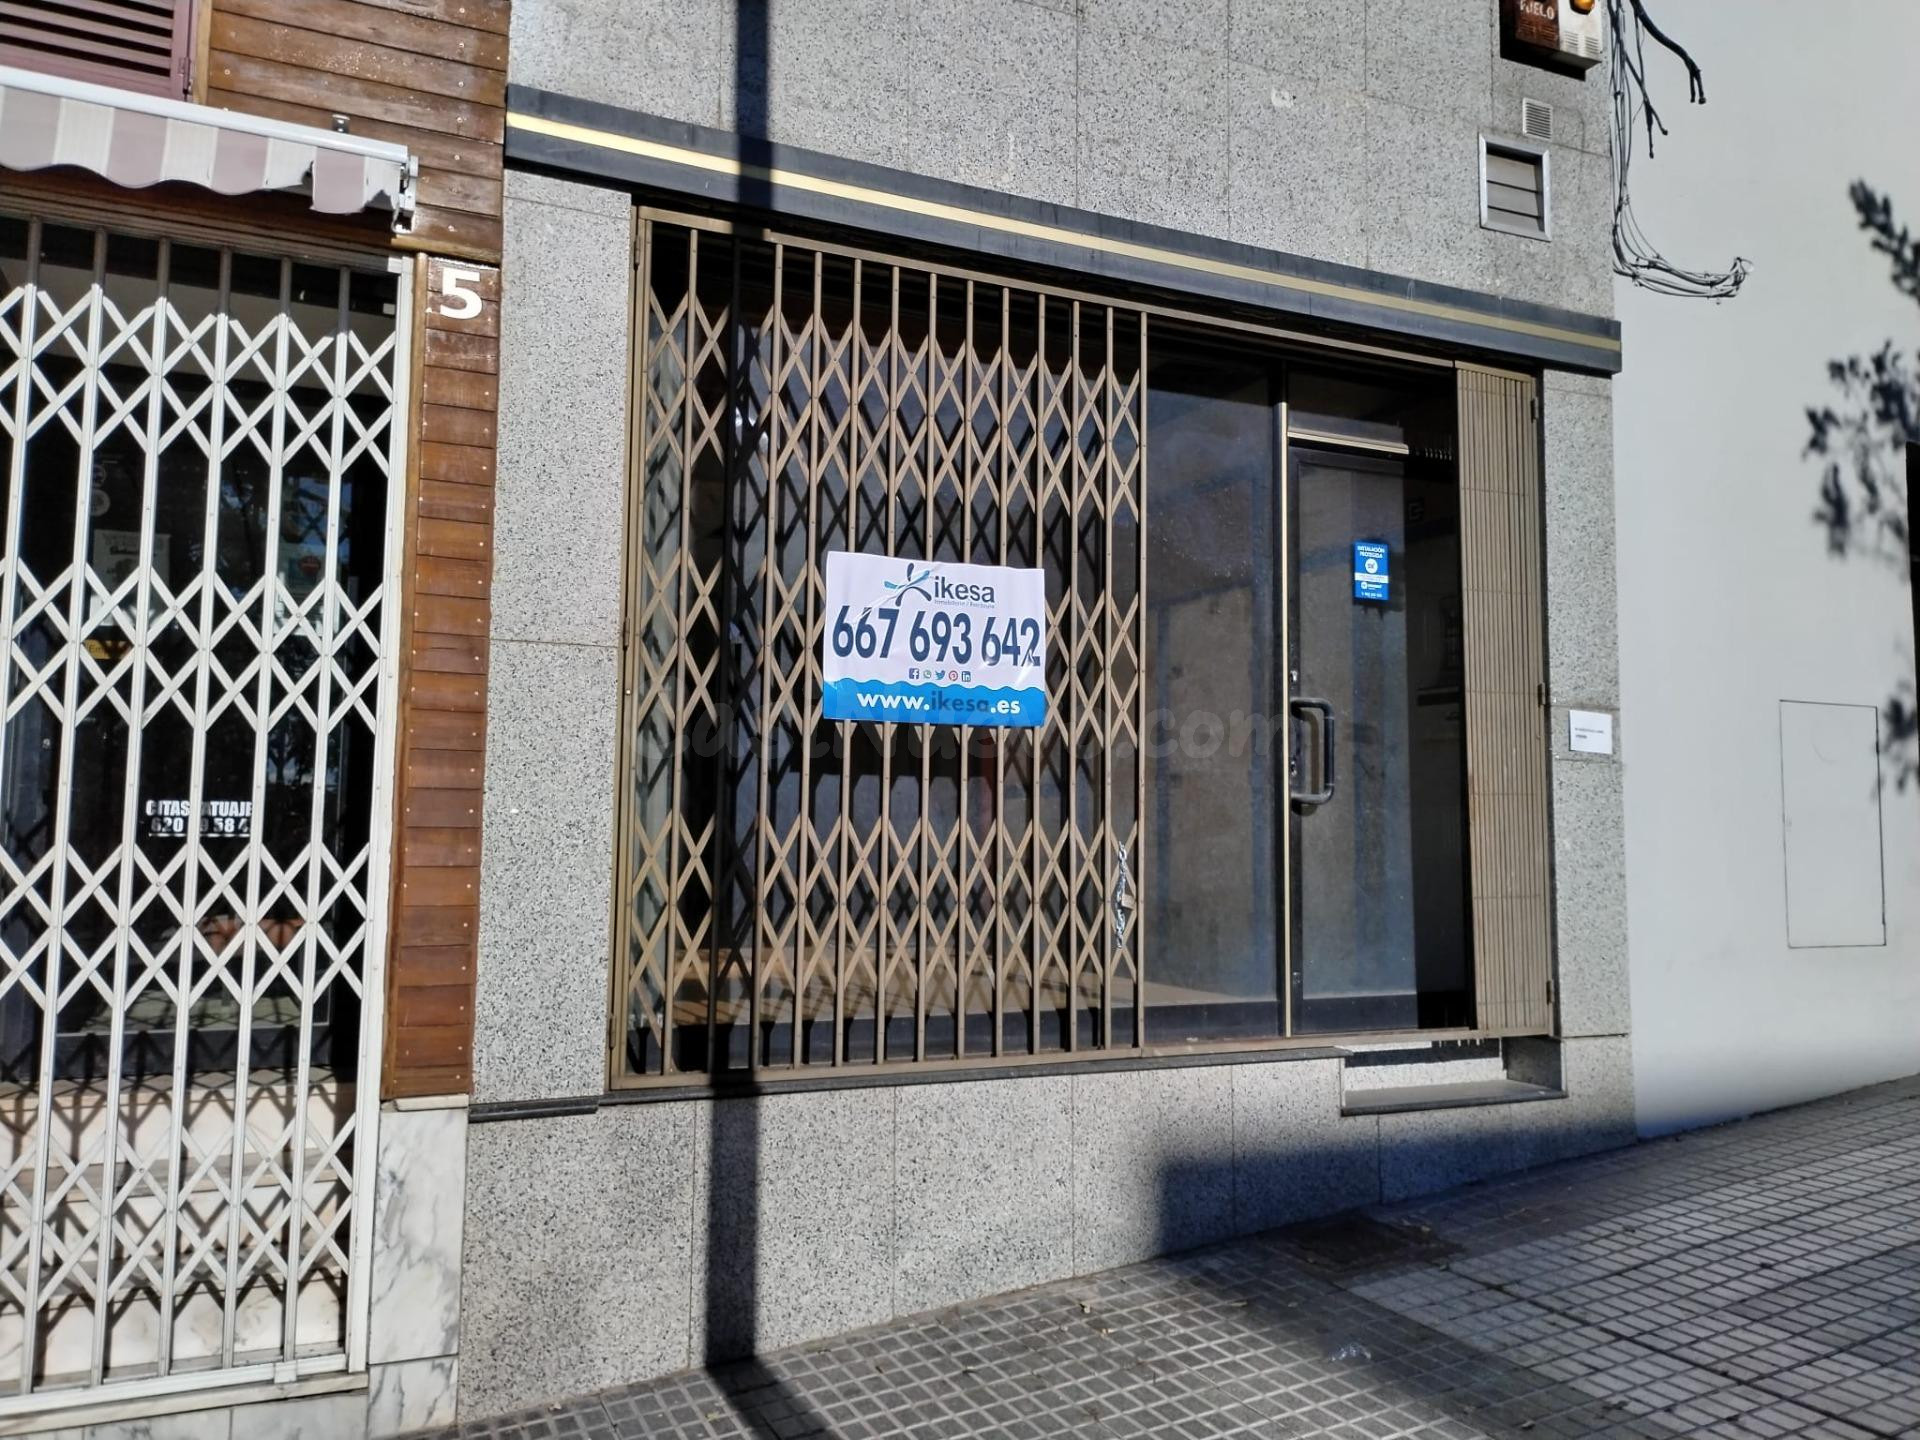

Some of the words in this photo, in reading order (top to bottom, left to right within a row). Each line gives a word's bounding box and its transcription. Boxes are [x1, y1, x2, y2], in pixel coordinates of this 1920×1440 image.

[440, 267, 483, 320] 5
[934, 576, 995, 603] ikesa
[832, 605, 900, 659] 667
[909, 610, 973, 665] 693
[981, 616, 1041, 668] 642
[857, 690, 1021, 714] www.ikesa.es
[145, 800, 192, 817] CITAS
[151, 817, 184, 833] 620
[213, 818, 235, 833] 58
